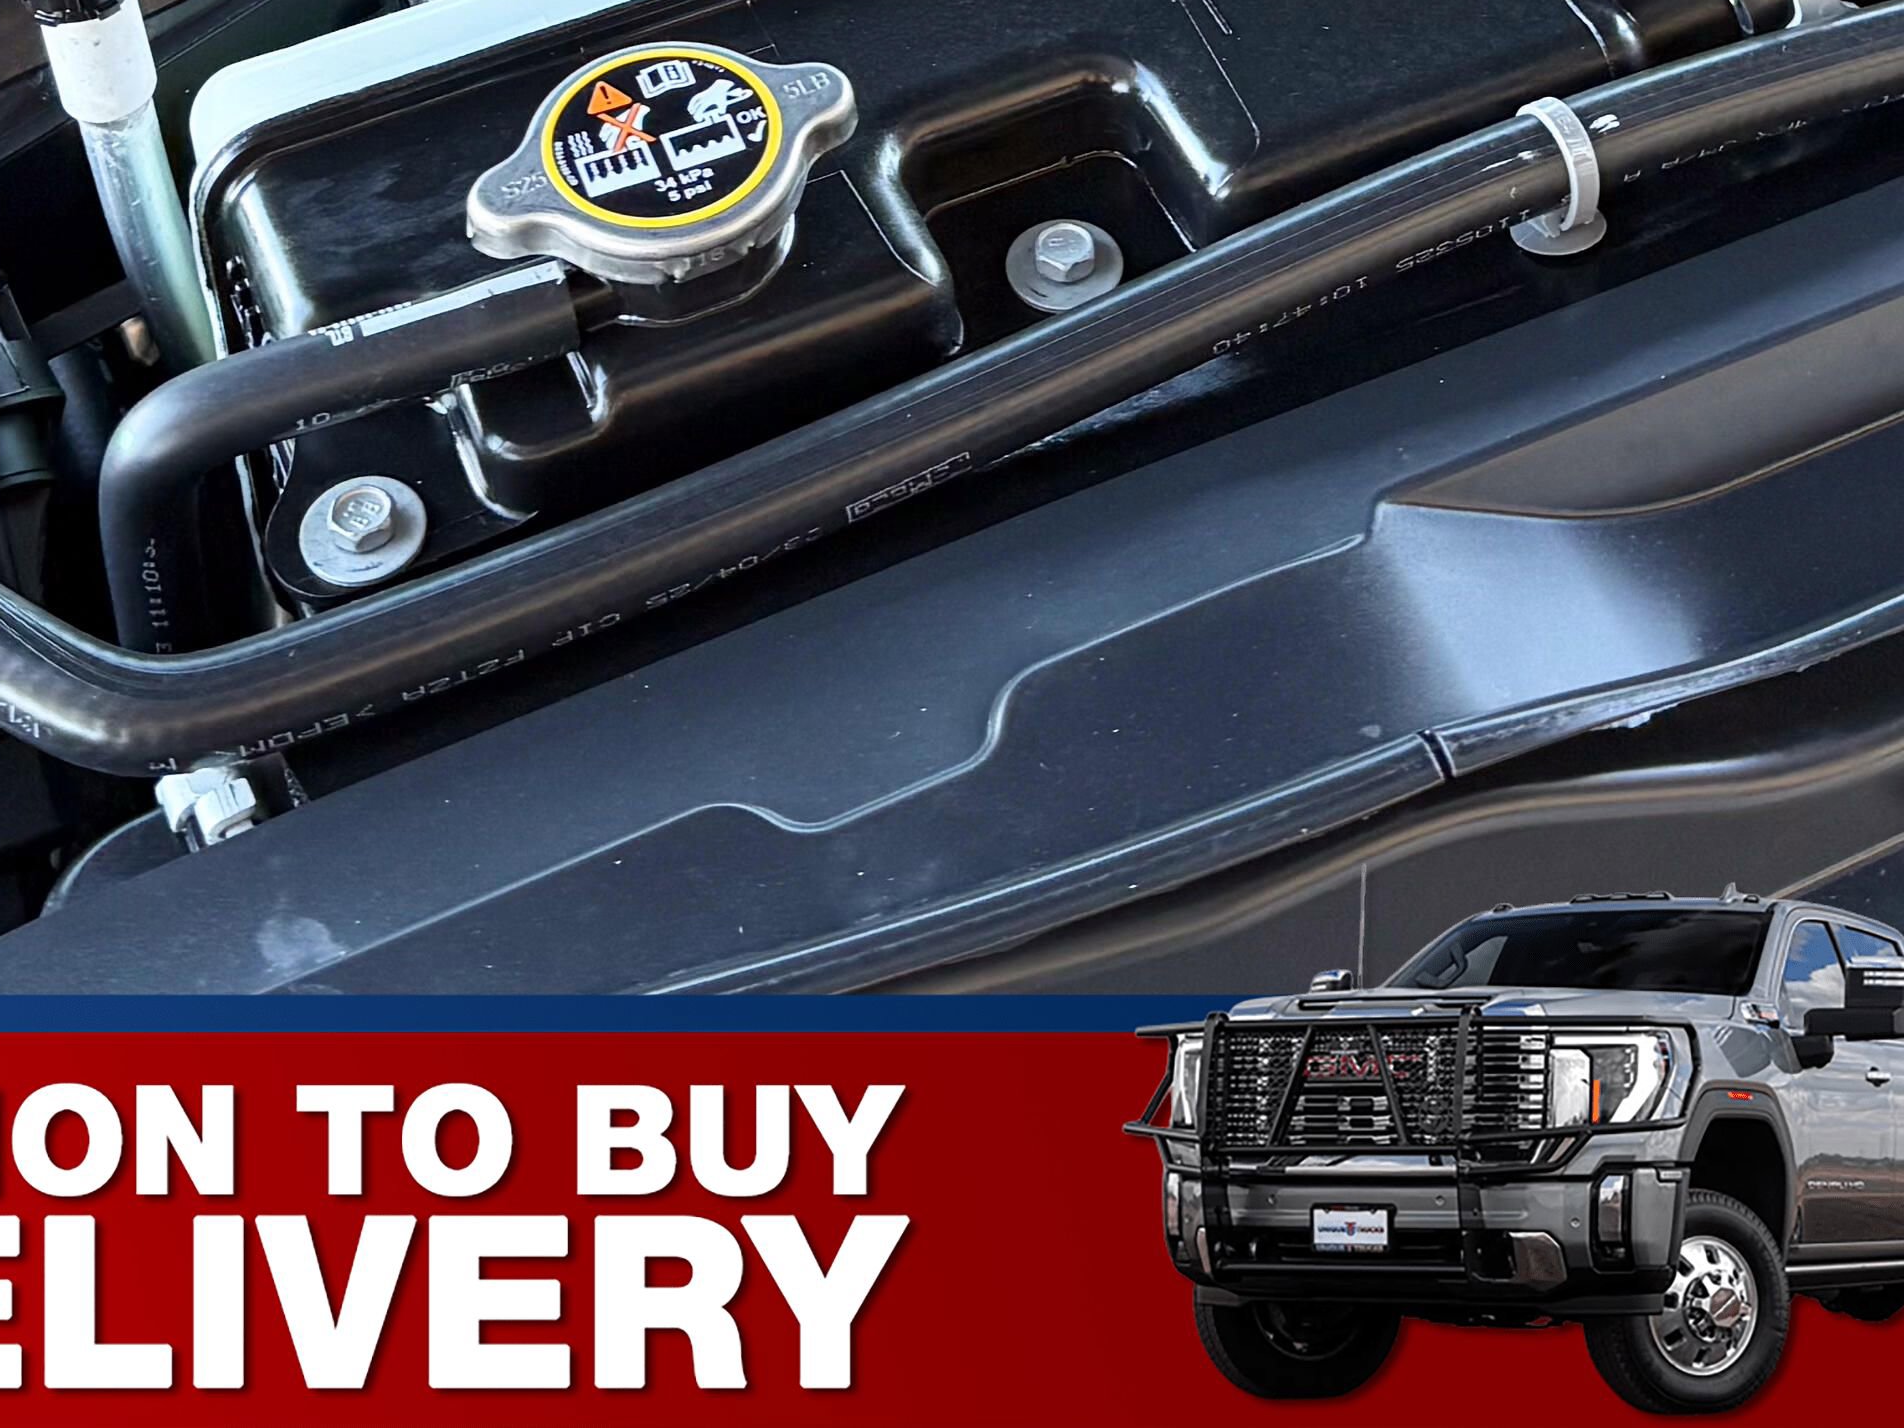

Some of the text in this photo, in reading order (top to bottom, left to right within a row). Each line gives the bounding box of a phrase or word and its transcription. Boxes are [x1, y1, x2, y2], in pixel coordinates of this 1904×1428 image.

[736, 107, 767, 125] OK
[654, 166, 714, 194] 34 kPa
[668, 183, 714, 202] 5 psi
